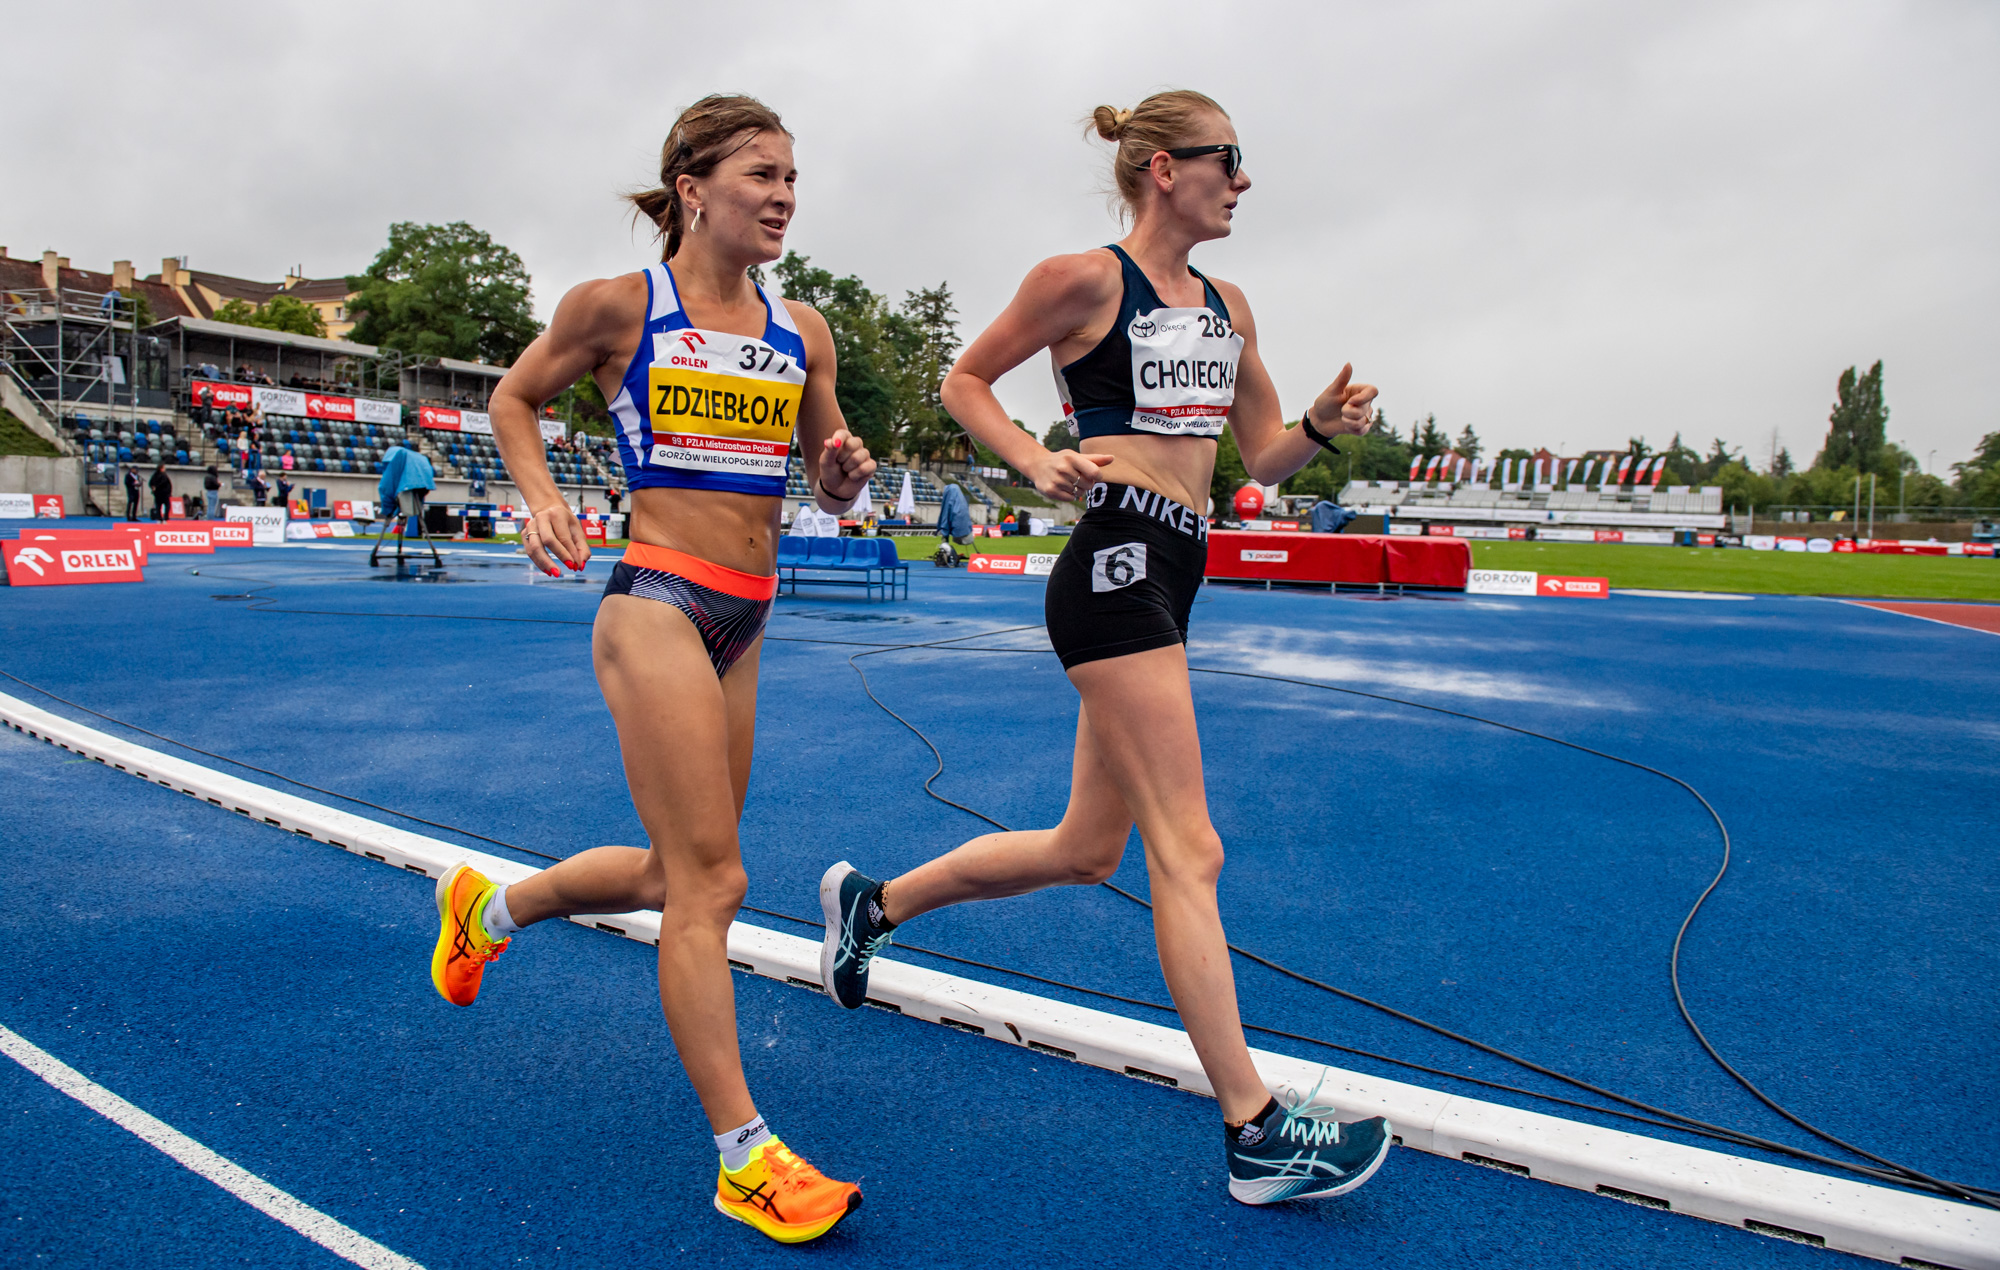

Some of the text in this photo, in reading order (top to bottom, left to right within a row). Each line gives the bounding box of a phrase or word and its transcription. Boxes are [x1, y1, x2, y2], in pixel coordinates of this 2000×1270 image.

[671, 355, 708, 369] ORLEN
[1140, 359, 1234, 390] CHOJECKA
[216, 389, 250, 403] ORLEN
[259, 391, 298, 405] GORZÓW
[324, 402, 353, 414] ORLEN
[361, 402, 394, 415] GORZÓW
[1170, 408, 1185, 417] PZLA
[436, 413, 459, 425] ORLEN
[1140, 415, 1181, 430] GORZÓW
[541, 421, 562, 432] ORZÓW
[672, 436, 775, 454] 99. PZLA Mistrzostwa Polski
[659, 449, 782, 469] GORZÓW WIELKOPOLSKI 2023
[1119, 485, 1195, 536] NIKE
[229, 514, 282, 526] GORZÓW
[160, 534, 206, 543] ORLEN
[214, 529, 246, 538] RLEN
[67, 553, 130, 569] ORLEN
[992, 560, 1019, 568] ORLEN
[1030, 555, 1058, 565] GOR
[1105, 546, 1135, 586] 6
[1473, 571, 1533, 584] GORZÓW
